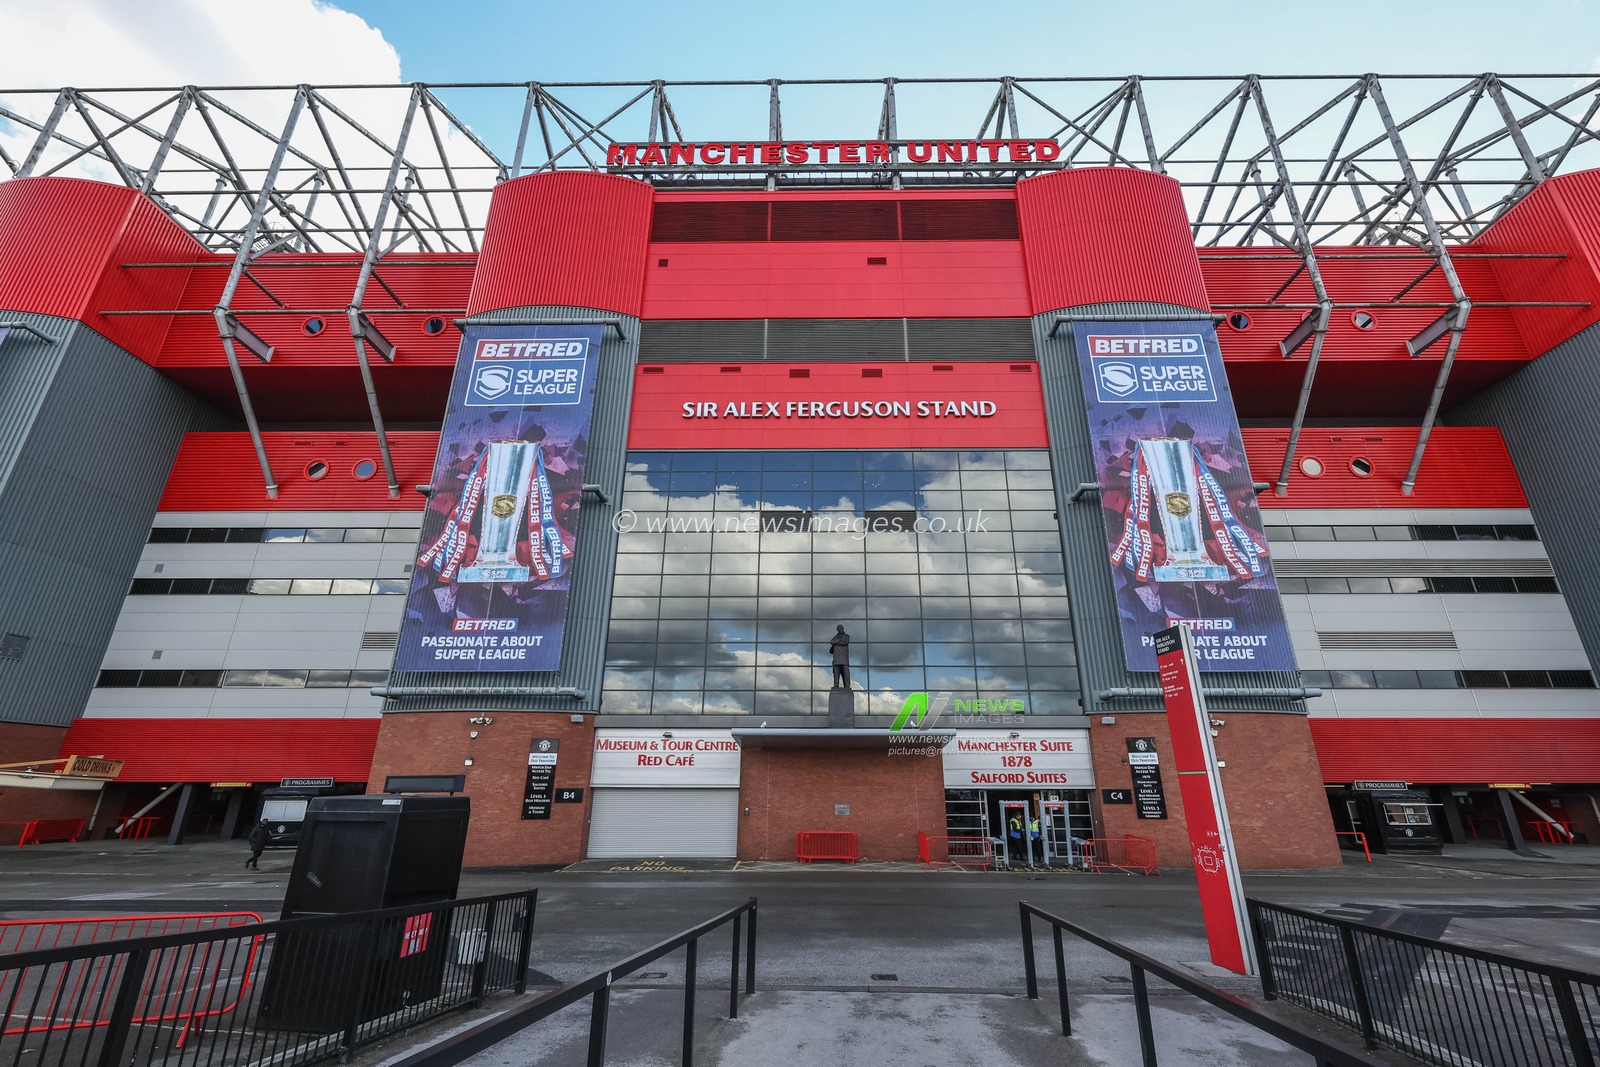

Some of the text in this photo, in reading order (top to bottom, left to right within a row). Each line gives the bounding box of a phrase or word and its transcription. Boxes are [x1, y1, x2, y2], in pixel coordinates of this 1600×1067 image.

[606, 141, 1061, 165] MANCHESTER UNITED
[480, 342, 583, 358] BETFRED
[1095, 339, 1198, 354] BETFRED
[515, 369, 578, 383] SUPER
[1139, 366, 1206, 380] SUPER
[514, 383, 577, 395] LEAGUE
[1143, 380, 1208, 392] LEAGUE
[682, 401, 997, 417] SIR ALEX FERGUSON STAND
[462, 477, 482, 523] BETFRED
[530, 478, 540, 523] BETFRED
[540, 475, 552, 520] BETFRED
[1139, 474, 1148, 522] BETFRED
[1198, 475, 1220, 522] BETFRED
[1204, 472, 1233, 518] BETFRED
[420, 519, 456, 563] BETFRED
[1112, 518, 1134, 562] BETFRED
[442, 530, 467, 578] BETFRED
[530, 531, 548, 576] BETFRED
[546, 527, 560, 574] BETFRED
[1138, 528, 1152, 578] BETFRED
[1216, 530, 1248, 575] BETFRED
[1231, 526, 1260, 572] BETFRED
[454, 620, 516, 631] BETFRED
[421, 636, 544, 647] PASSIONATE ABOUT
[1224, 636, 1267, 646] ABOUT
[434, 649, 526, 660] SUPER LEAGUE
[1205, 648, 1255, 660] LEAGUE
[596, 739, 738, 750] MUSEUM & TOUR CENTRE
[958, 740, 1073, 752] MANCHESTER SUITE
[72, 760, 112, 773] COLD DRINKS
[638, 754, 694, 766] RED CAFÉ
[1001, 756, 1033, 768] 1878
[971, 772, 1067, 783] SALFORD SUITES
